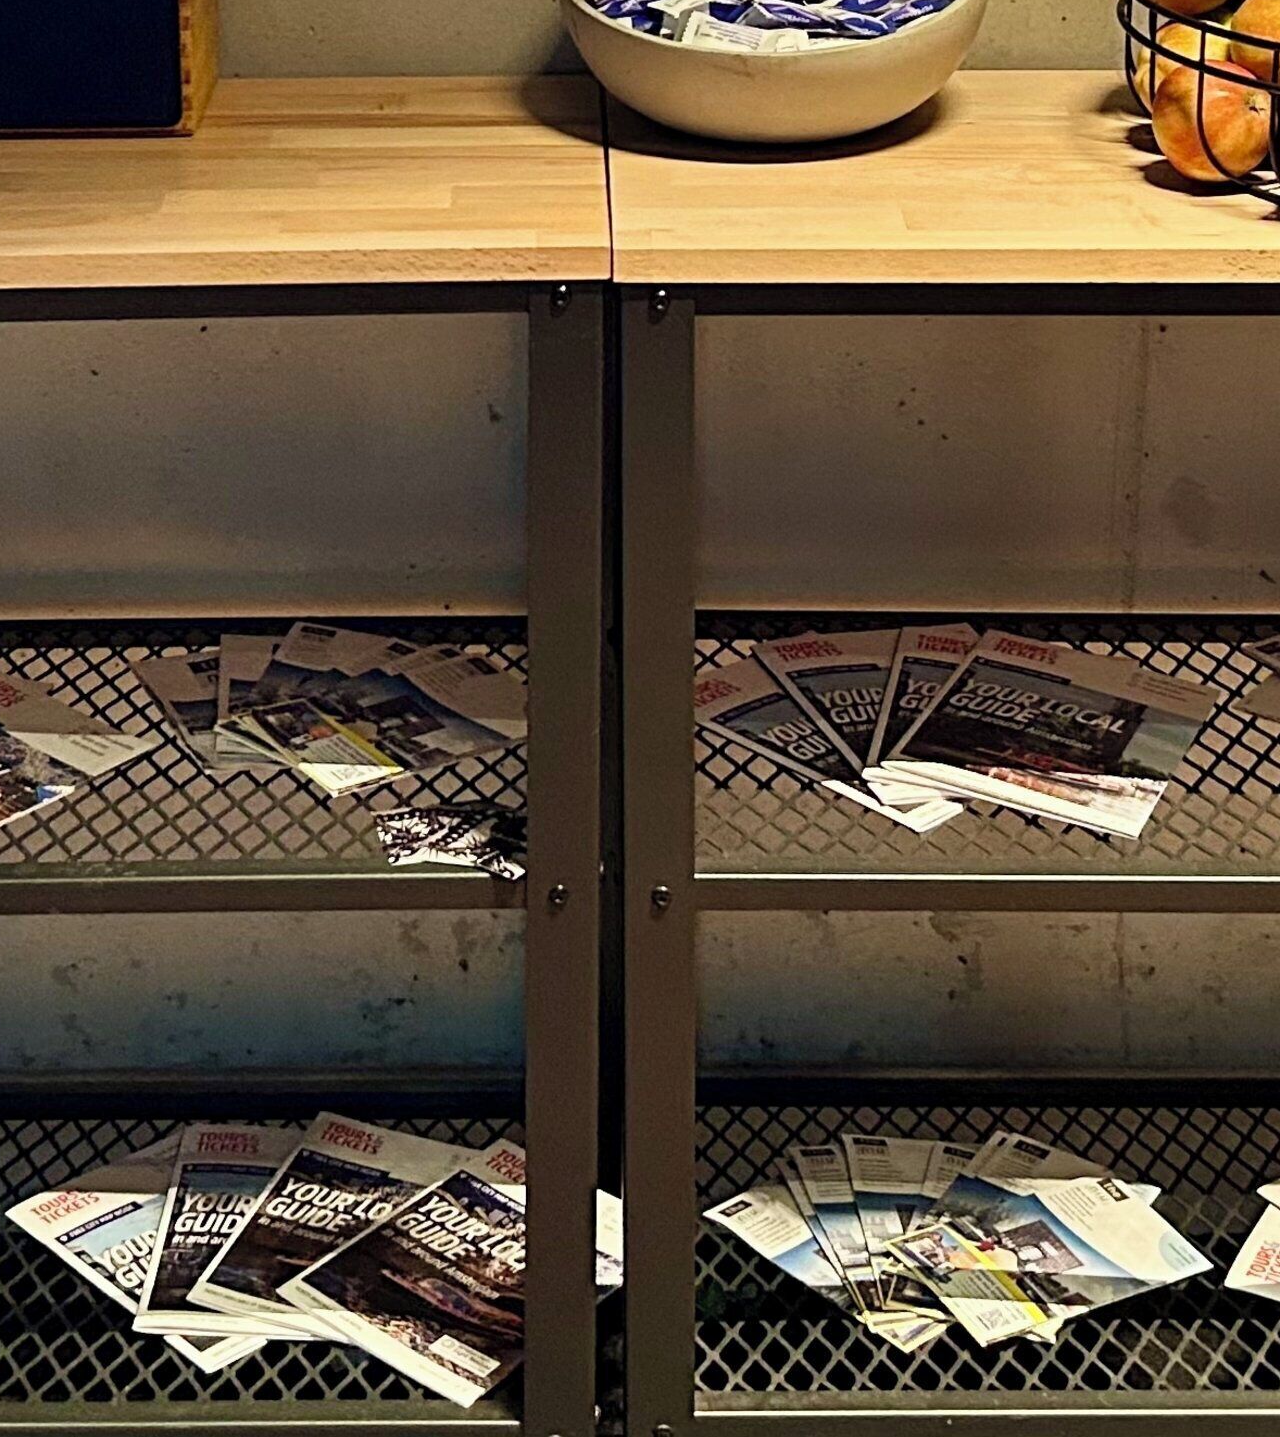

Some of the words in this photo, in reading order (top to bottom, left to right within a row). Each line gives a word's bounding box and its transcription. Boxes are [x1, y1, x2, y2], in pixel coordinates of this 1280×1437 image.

[949, 694, 1039, 723] GUIDE
[966, 678, 1039, 708] YOUR
[1043, 700, 1124, 733] LOCAL
[322, 1132, 379, 1154] TICKETS
[40, 1193, 101, 1224] TICKETS
[183, 1192, 257, 1213] YOUR
[280, 1177, 355, 1212] YOUR
[266, 1197, 352, 1232] GUIDE
[419, 1196, 489, 1243] YOUR
[396, 1213, 476, 1261] GUIDE
